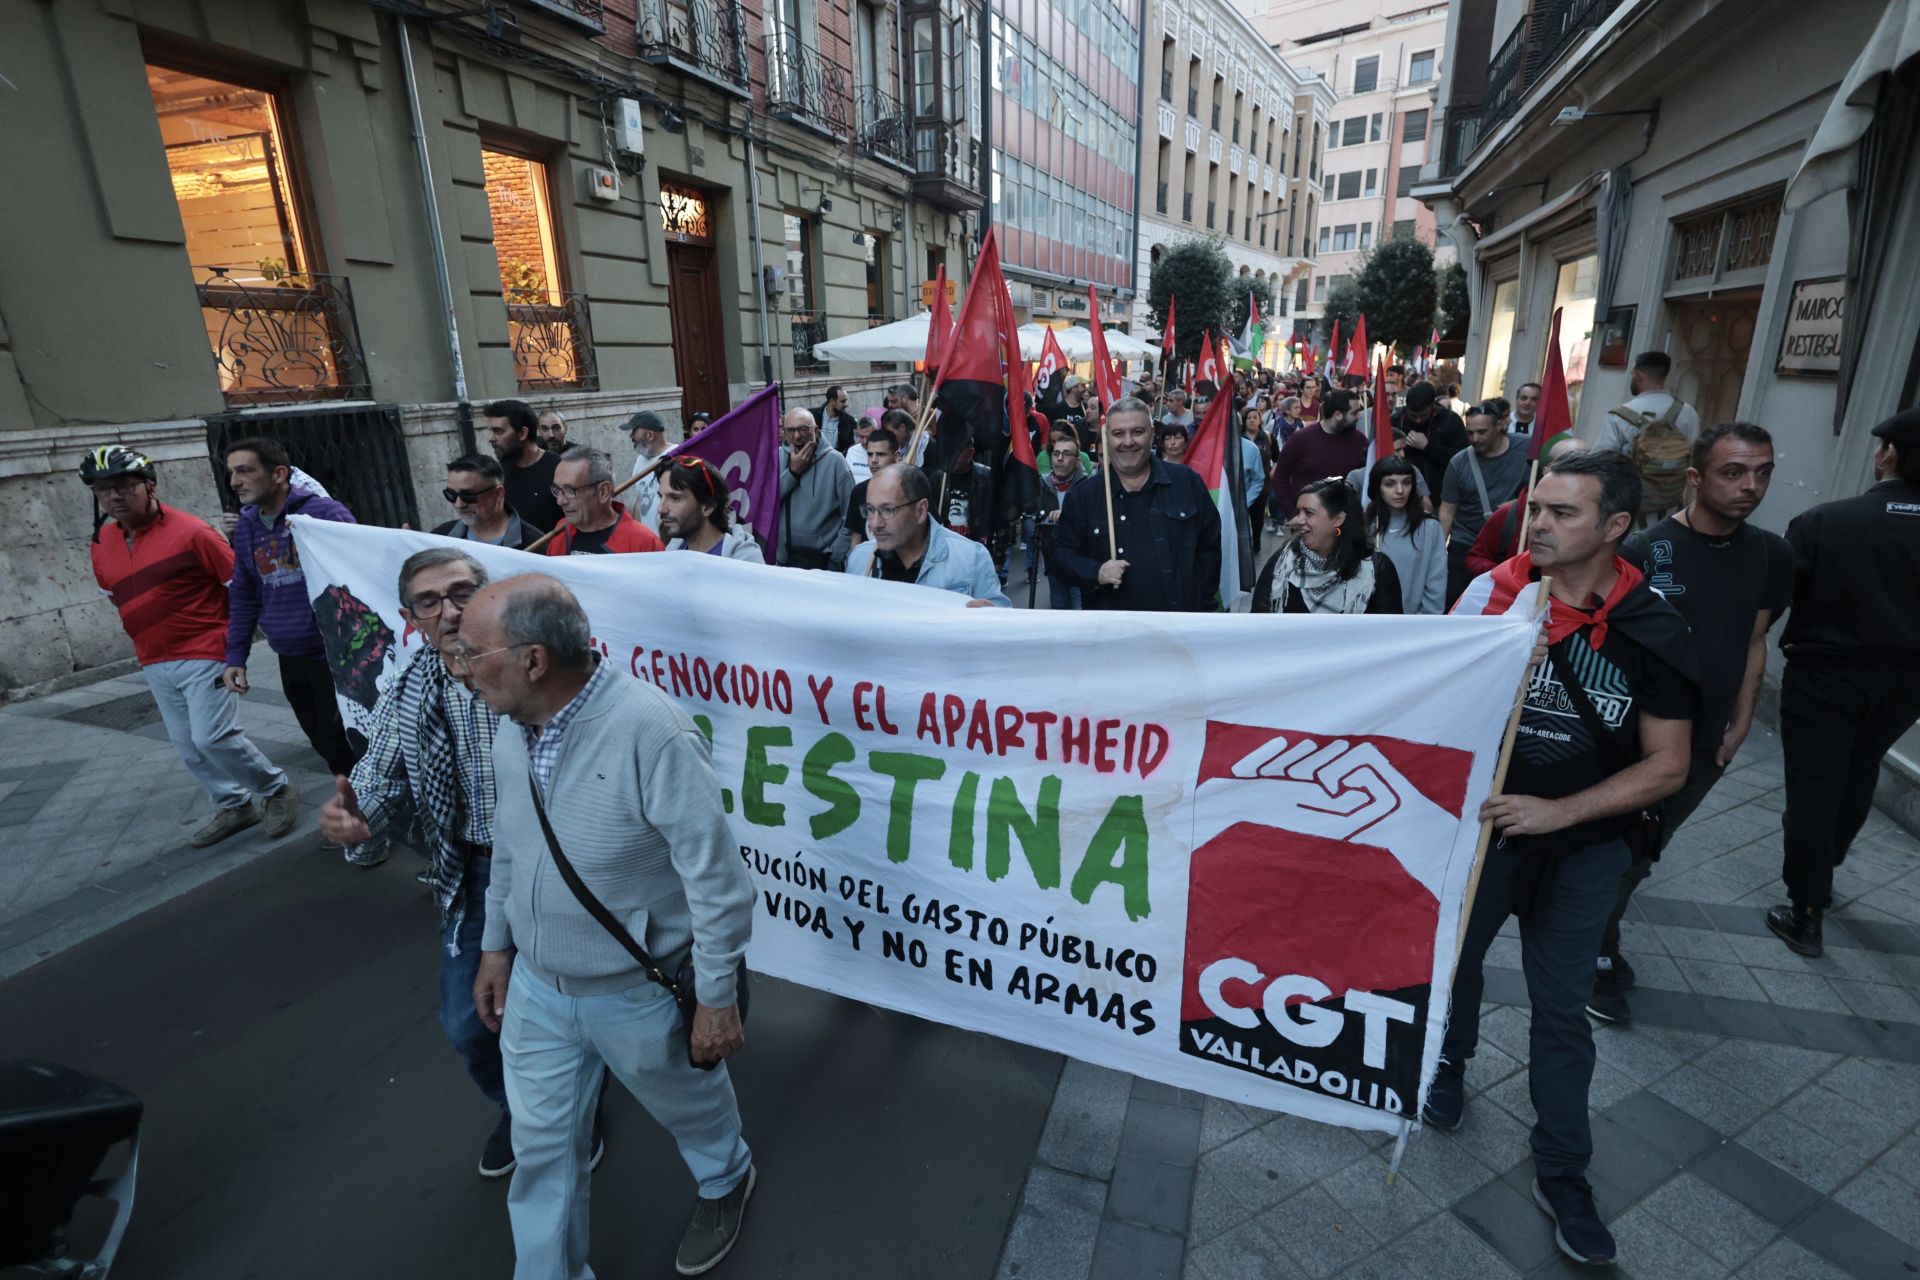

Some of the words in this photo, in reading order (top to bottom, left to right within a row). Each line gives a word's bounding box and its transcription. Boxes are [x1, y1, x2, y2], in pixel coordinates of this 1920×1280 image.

[630, 645, 793, 715] GENOCIDIO
[807, 674, 835, 726] Y
[853, 681, 899, 736] EL
[916, 691, 1170, 780] APARTHEID
[764, 890, 834, 939] VIDA
[842, 916, 866, 951] Y
[882, 931, 928, 969] NO
[945, 950, 994, 991] EN
[1008, 967, 1157, 1036] ARMAS
[838, 874, 890, 916] DEL
[902, 895, 1009, 946] GASTO
[1019, 916, 1158, 983] PÚBLICO
[1190, 1027, 1404, 1114] VALLADOLID
[1199, 957, 1416, 1071] CGT
